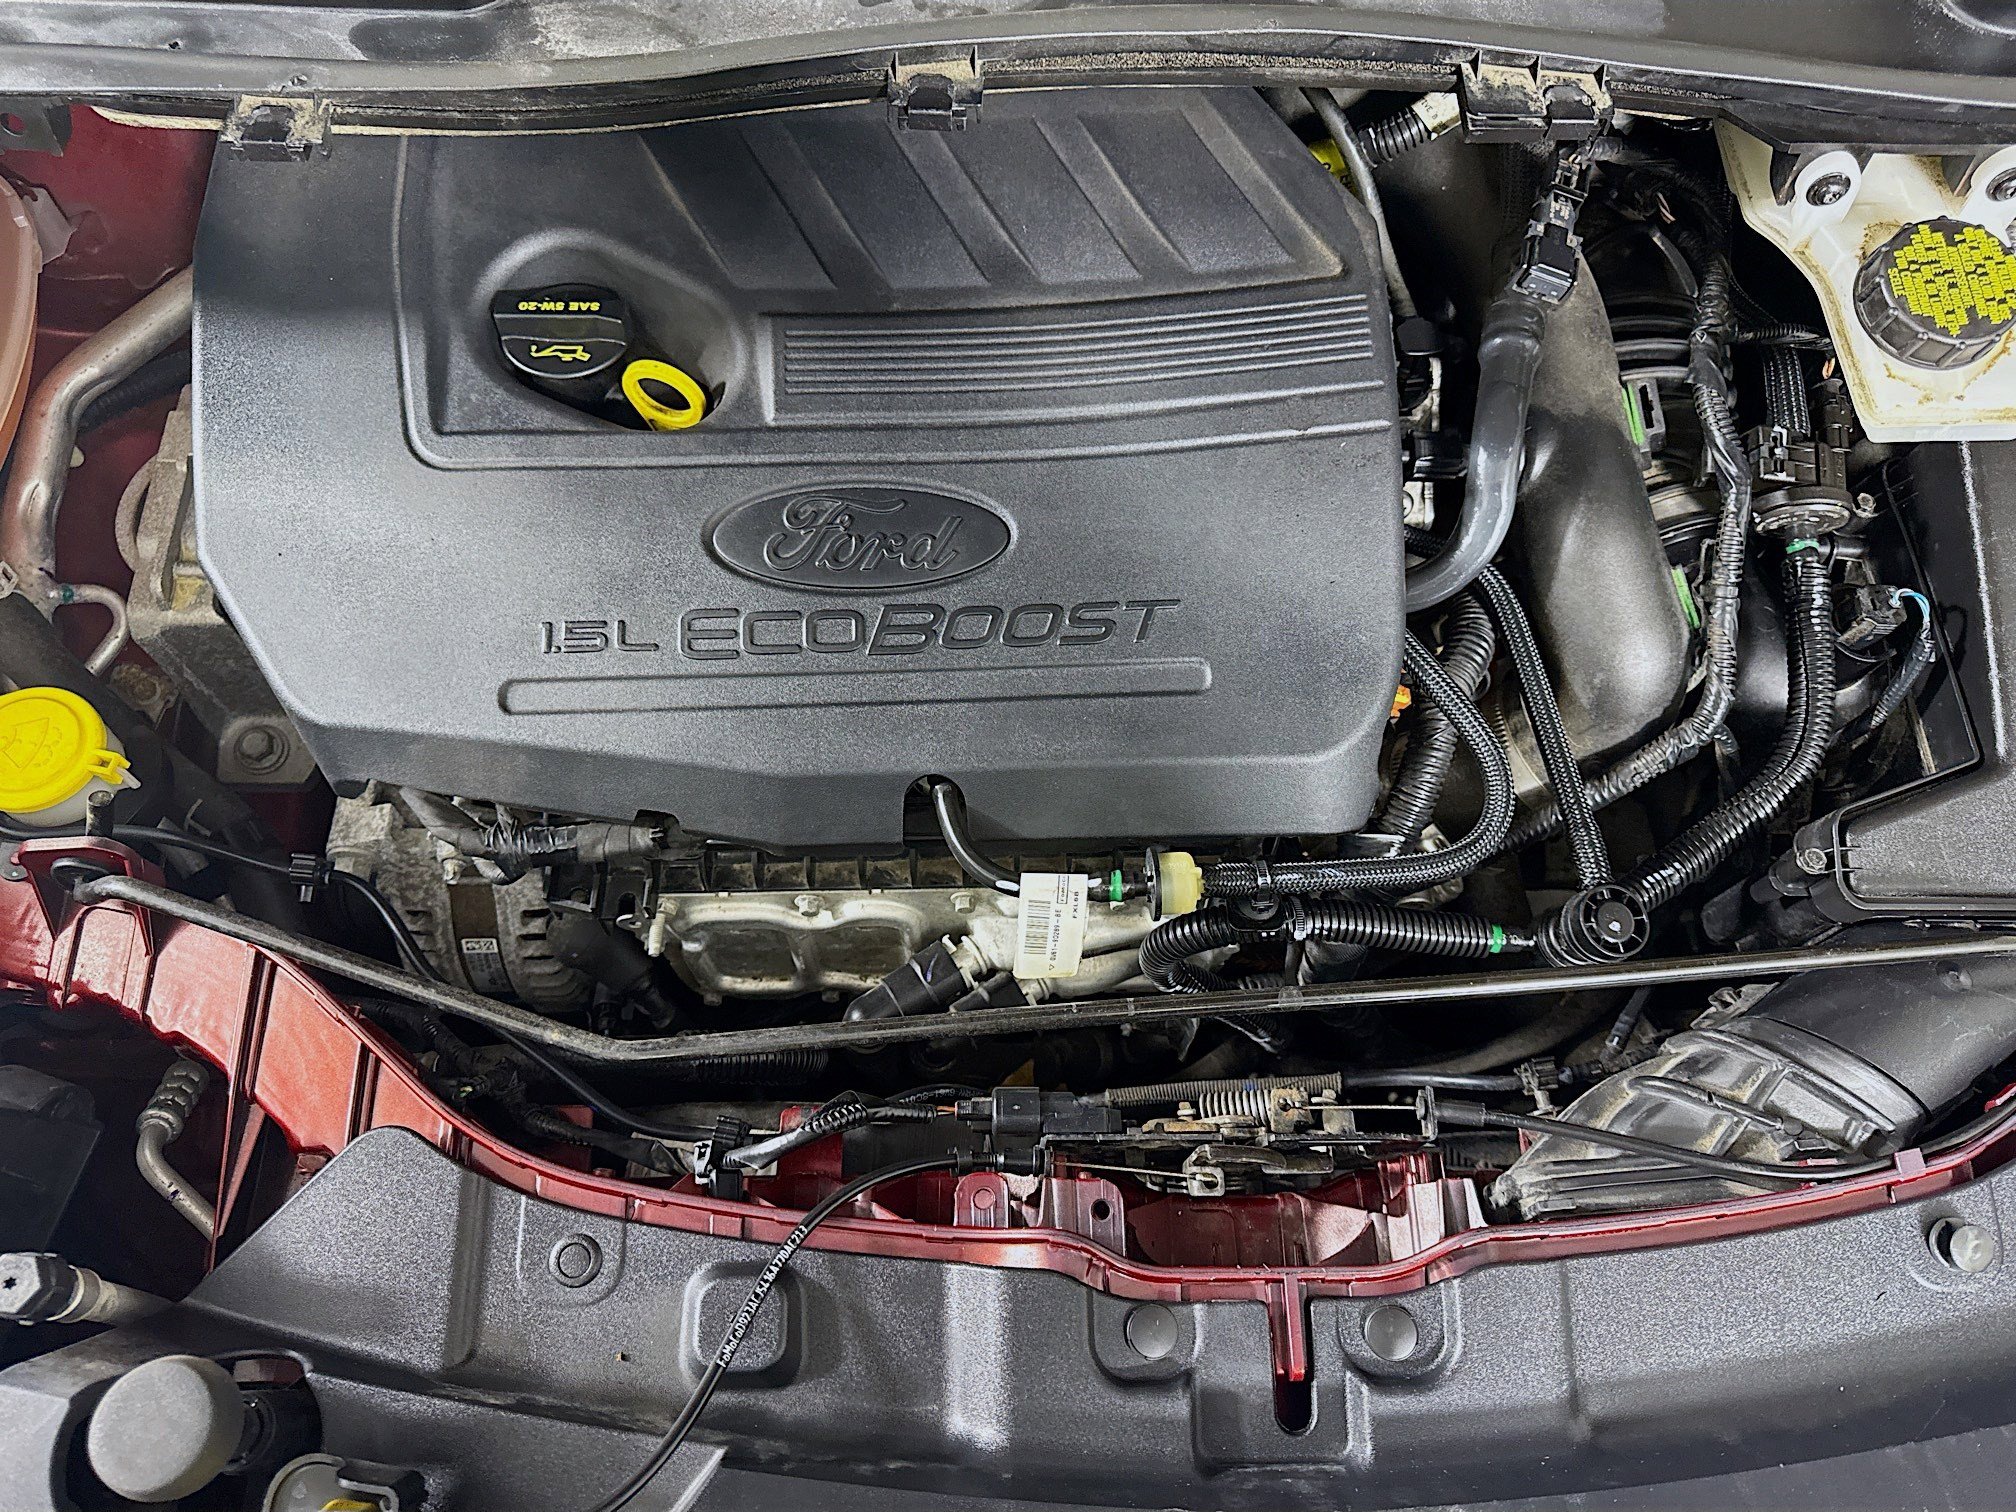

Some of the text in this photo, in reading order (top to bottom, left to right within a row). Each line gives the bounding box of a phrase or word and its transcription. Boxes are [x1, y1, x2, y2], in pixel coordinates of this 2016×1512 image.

[1917, 224, 1935, 249] AVANT
[1953, 233, 1966, 242] A
[1962, 227, 1979, 248] ONLY
[1926, 250, 1940, 262] DE
[1930, 263, 1944, 275] LE
[1957, 242, 1976, 273] SEALED
[1970, 249, 1985, 266] DOT
[1987, 237, 2005, 264] CLEAN
[1997, 264, 2016, 291] FILLER
[1903, 245, 1918, 262] DOT
[1911, 272, 1935, 317] PROVENANT
[1910, 233, 1948, 329] PLOYER QUE DU LIQUIDE
[1931, 231, 1969, 326] NETTOYER LE BOUCHON
[1974, 228, 1994, 260] BEFORE
[1997, 303, 2013, 320] USE
[1978, 275, 1995, 299] FLUID
[518, 301, 601, 312] SAE 5W-20
[1900, 271, 1924, 316] CONTENANT
[1986, 300, 2003, 325] FROM
[762, 495, 959, 572] Ford
[540, 619, 660, 654] 1.5L
